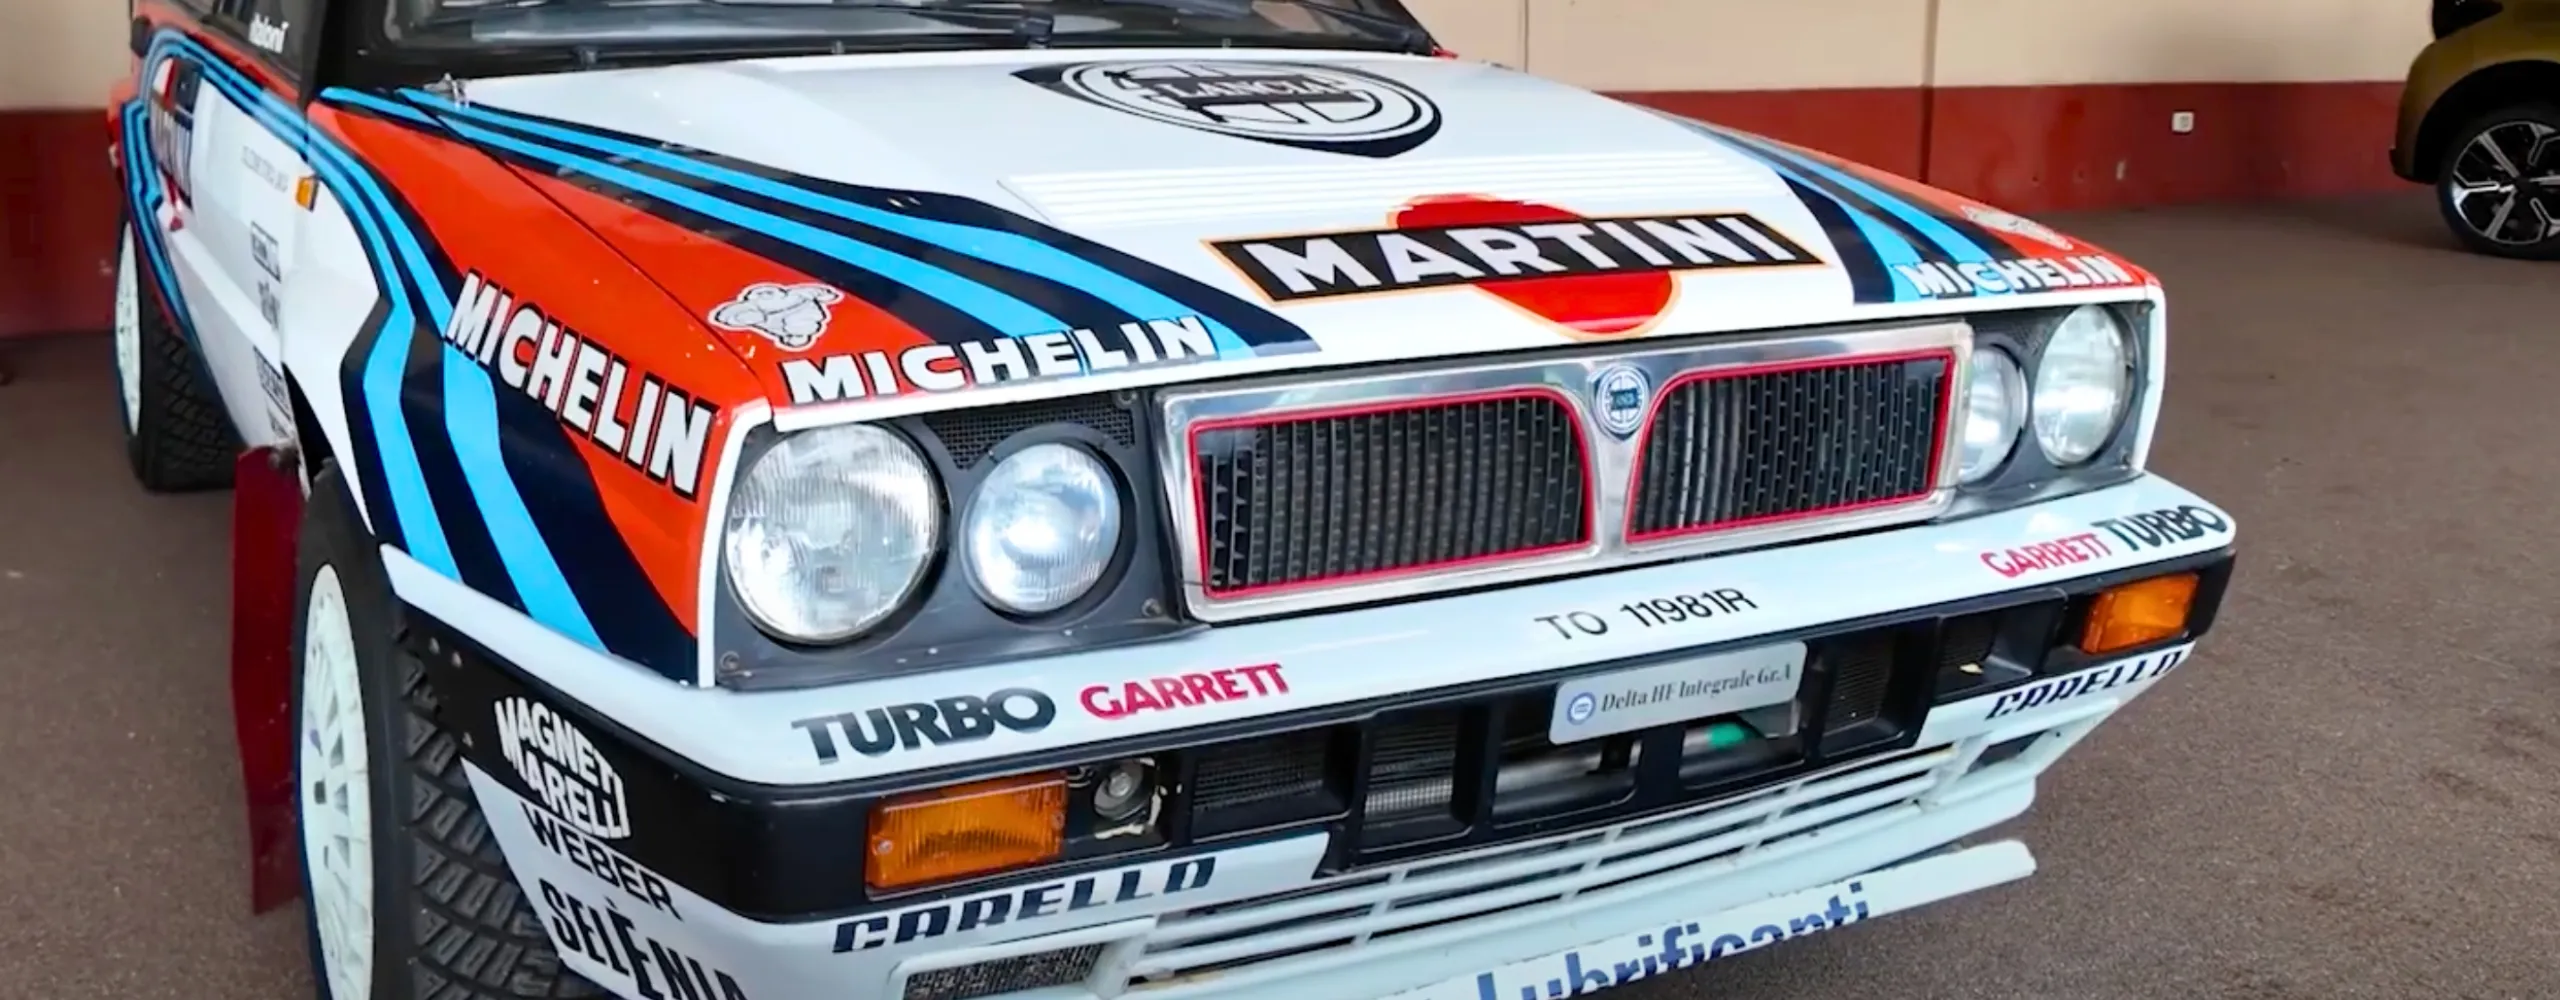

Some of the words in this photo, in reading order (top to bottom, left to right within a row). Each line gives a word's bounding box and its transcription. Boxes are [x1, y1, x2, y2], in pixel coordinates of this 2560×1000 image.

[1242, 214, 1792, 296] MARTINI
[1891, 254, 2135, 299] MICHELIN
[446, 268, 718, 500] MICHELIN
[779, 314, 1220, 404] MICHELIN
[1980, 533, 2113, 578] GARRETT
[2090, 505, 2228, 551] TURBO
[1534, 611, 1608, 640] TO
[1619, 587, 1759, 627] 11981R
[791, 687, 1057, 766] TURBO
[1079, 662, 1290, 720] GARRETT
[1600, 688, 1648, 713] Delta
[1650, 681, 1677, 704] HF
[1678, 669, 1756, 699] Integrale
[520, 799, 684, 923] WEBER
[831, 856, 1217, 953] CARELLO
